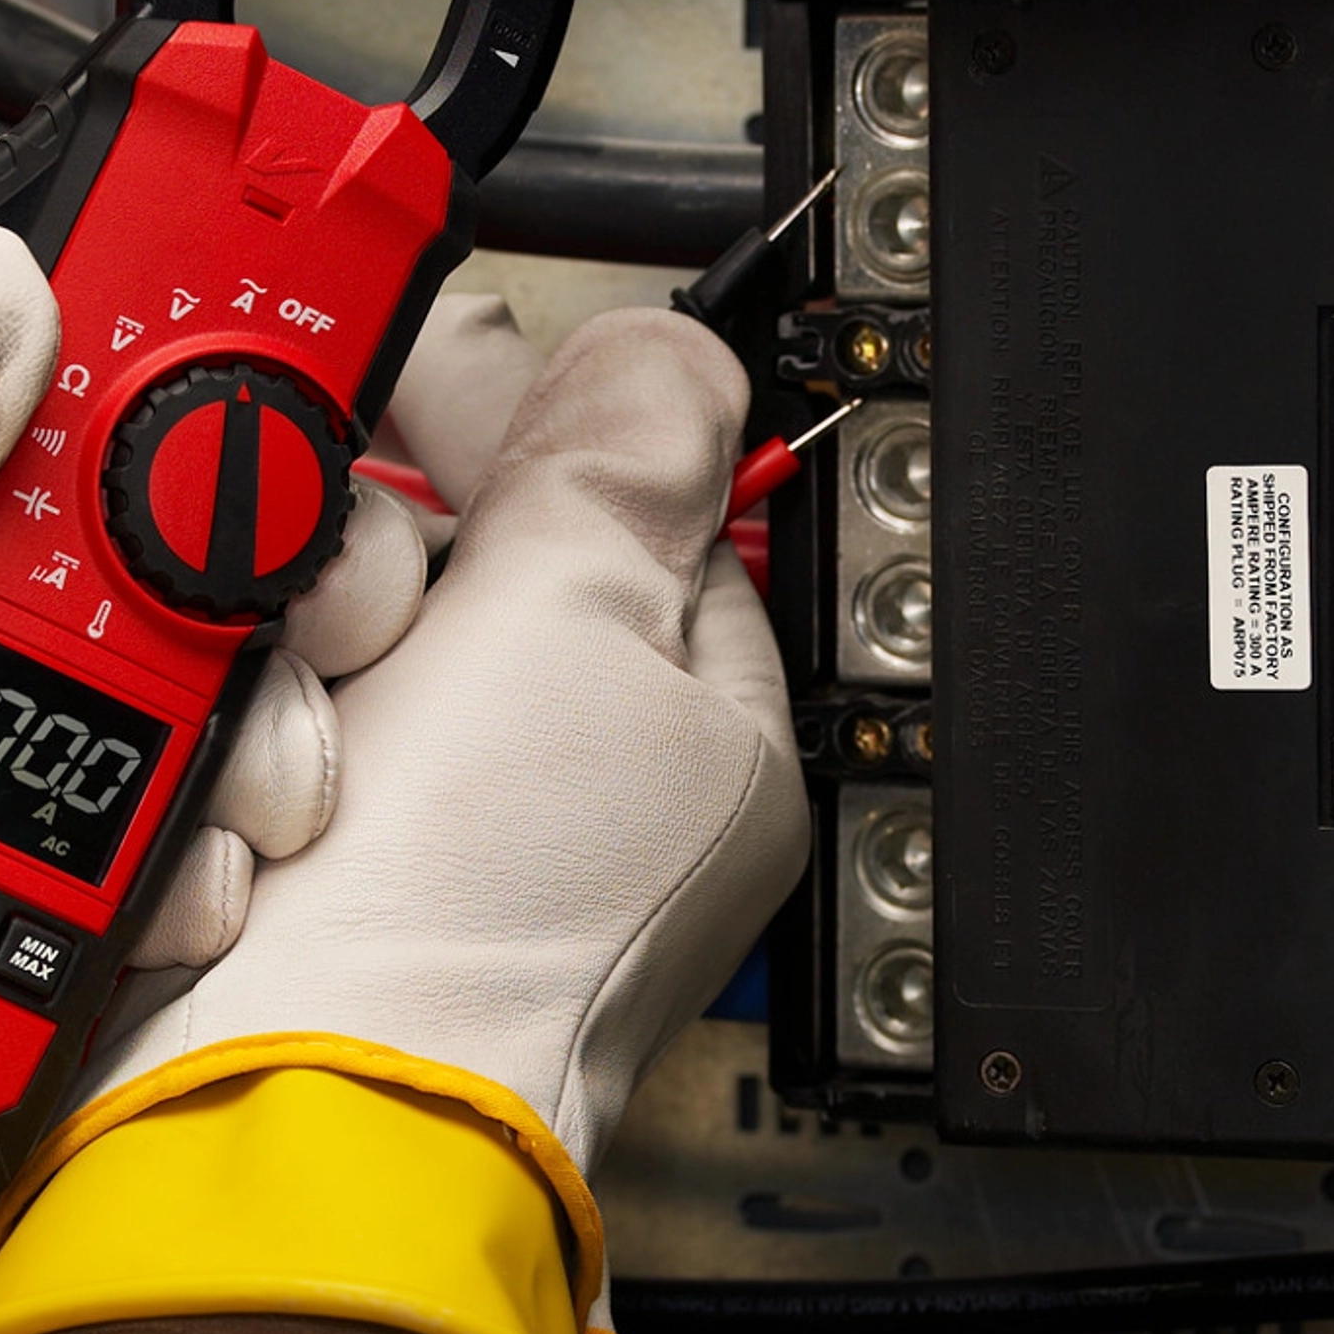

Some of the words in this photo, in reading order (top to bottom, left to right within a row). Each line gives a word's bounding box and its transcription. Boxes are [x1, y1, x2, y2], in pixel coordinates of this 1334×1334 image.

[278, 298, 336, 334] OFF
[1230, 477, 1244, 540] RATING
[1246, 478, 1260, 546] AMPERE
[1262, 473, 1276, 544] SHIPPED
[1231, 543, 1245, 589] PLUG
[1248, 551, 1262, 614] RATING
[1264, 547, 1278, 596] FROM
[1277, 492, 1293, 631] CONFIGURATION
[1233, 616, 1246, 678] ARP075
[1249, 633, 1263, 660] 300
[1264, 600, 1279, 680] FACTORY
[1280, 635, 1294, 659] AS
[1250, 664, 1263, 676] A
[31, 801, 58, 826] A
[40, 835, 71, 856] AC
[8, 952, 56, 982] MAX
[18, 935, 60, 963] MIN
